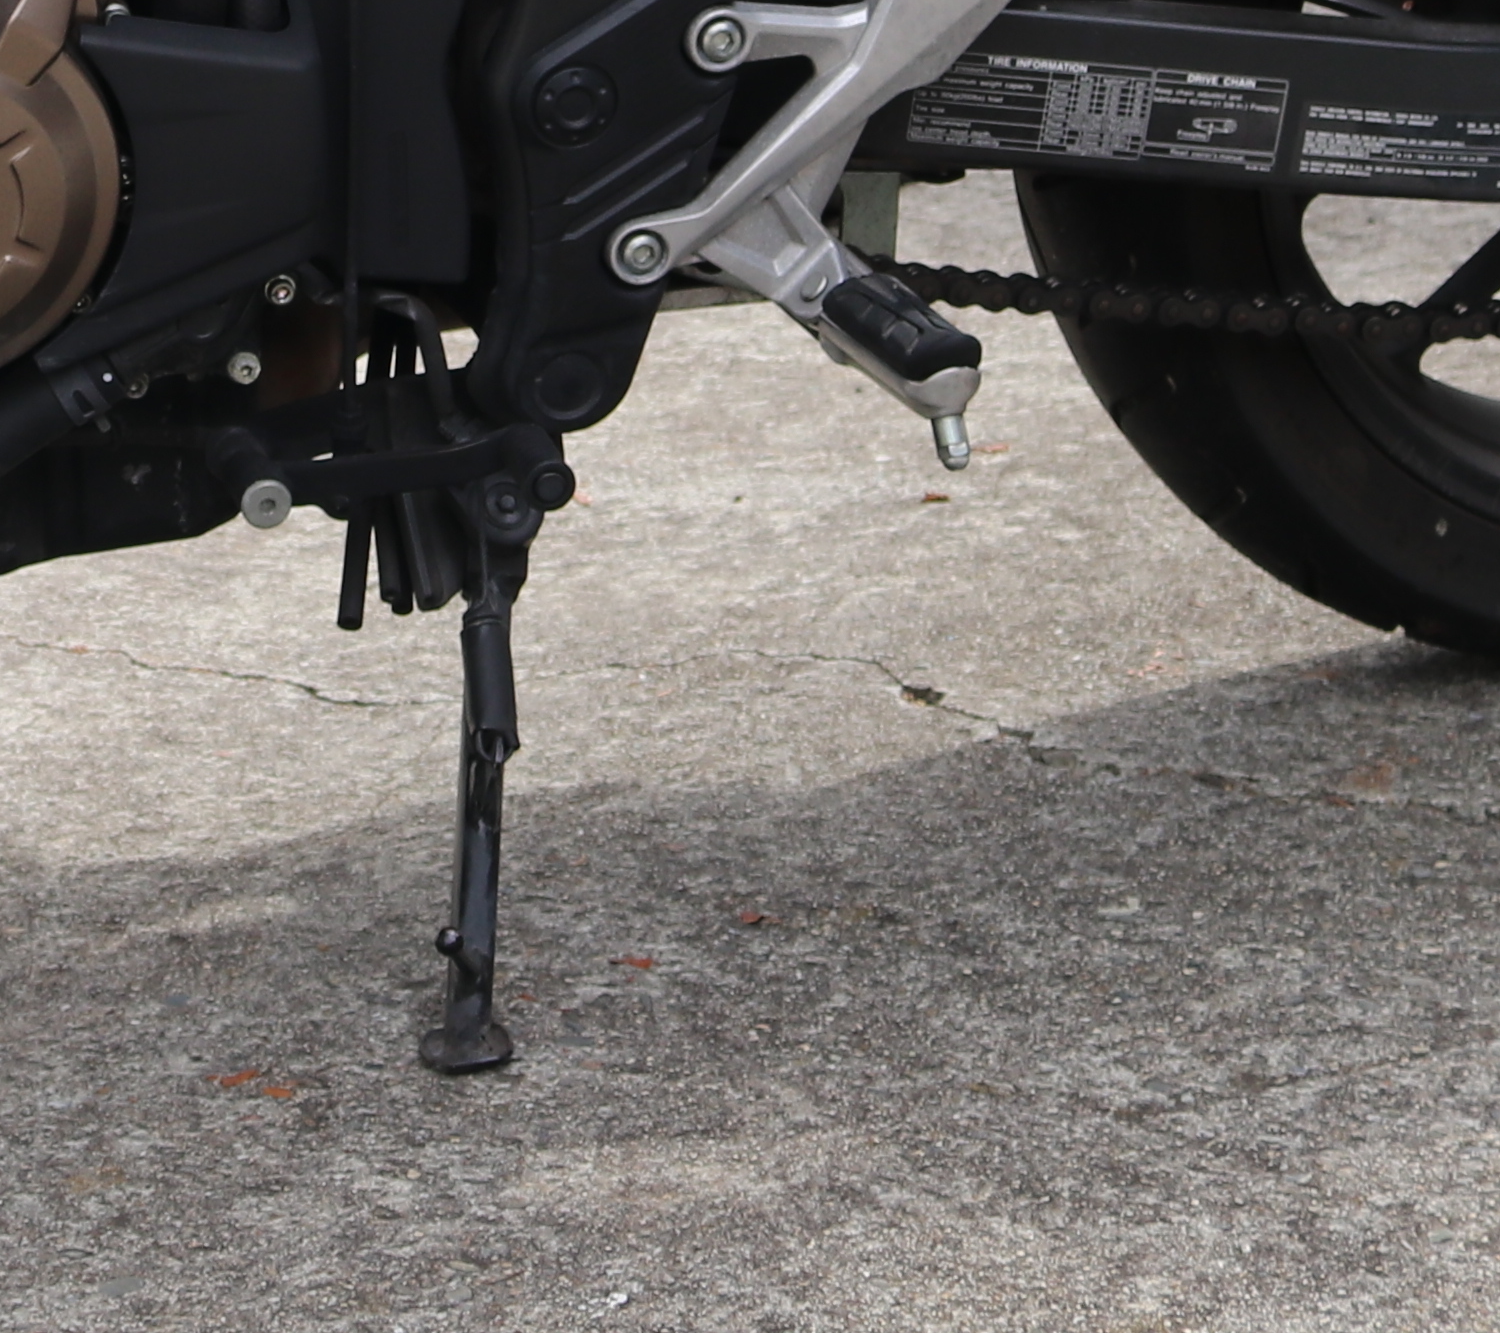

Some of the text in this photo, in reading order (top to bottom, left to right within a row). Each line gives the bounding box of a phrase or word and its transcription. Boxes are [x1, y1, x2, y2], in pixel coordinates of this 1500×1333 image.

[988, 55, 1088, 74] TIRE INFORMATION
[1187, 73, 1257, 90] DRIVE CHAIN
